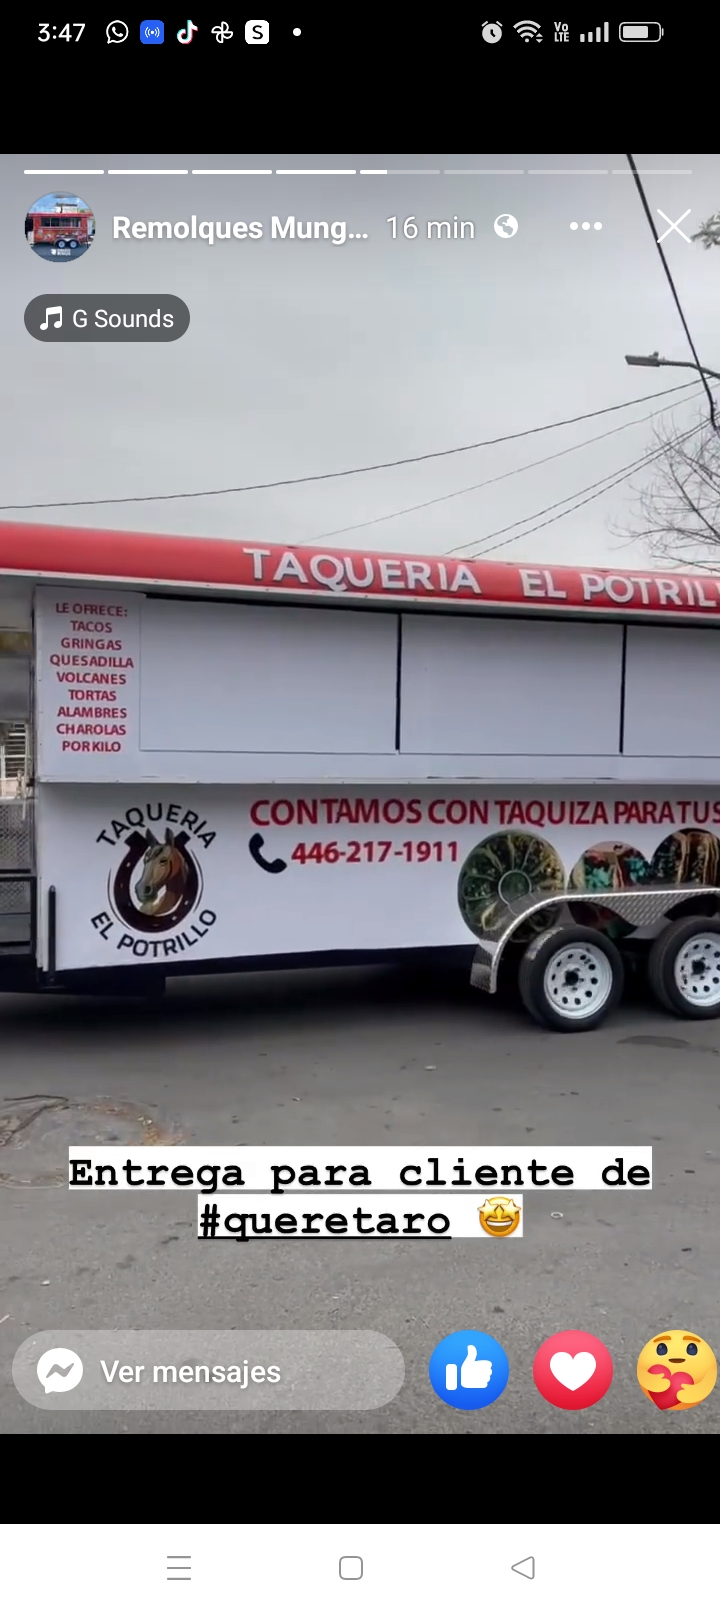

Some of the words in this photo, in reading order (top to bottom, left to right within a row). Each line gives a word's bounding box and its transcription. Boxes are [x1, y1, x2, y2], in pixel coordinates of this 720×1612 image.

[242, 547, 482, 595] TAQUERIA
[518, 569, 567, 599] EL
[579, 573, 720, 608] POTRIL
[55, 602, 71, 614] LE
[73, 603, 128, 618] OFRECE:
[70, 620, 113, 633] TACOS
[61, 637, 122, 651] GRINGAS
[49, 654, 134, 669] QUESADILLA
[56, 671, 126, 685] VOLCANES
[68, 689, 117, 702] TORTAS
[57, 706, 127, 719] ALAMBRES
[56, 723, 126, 736] CHAROLAS
[62, 740, 90, 753] POR
[92, 740, 121, 753] KILO
[250, 799, 422, 826] CONTAMOS
[427, 799, 488, 824] CON
[494, 800, 608, 827] TAQUIZA
[614, 801, 675, 824] PARA
[96, 803, 217, 849] TAQUERIA
[291, 840, 458, 865] 446-217-1911
[90, 911, 114, 941] EL
[116, 909, 217, 958] POTRILLO
